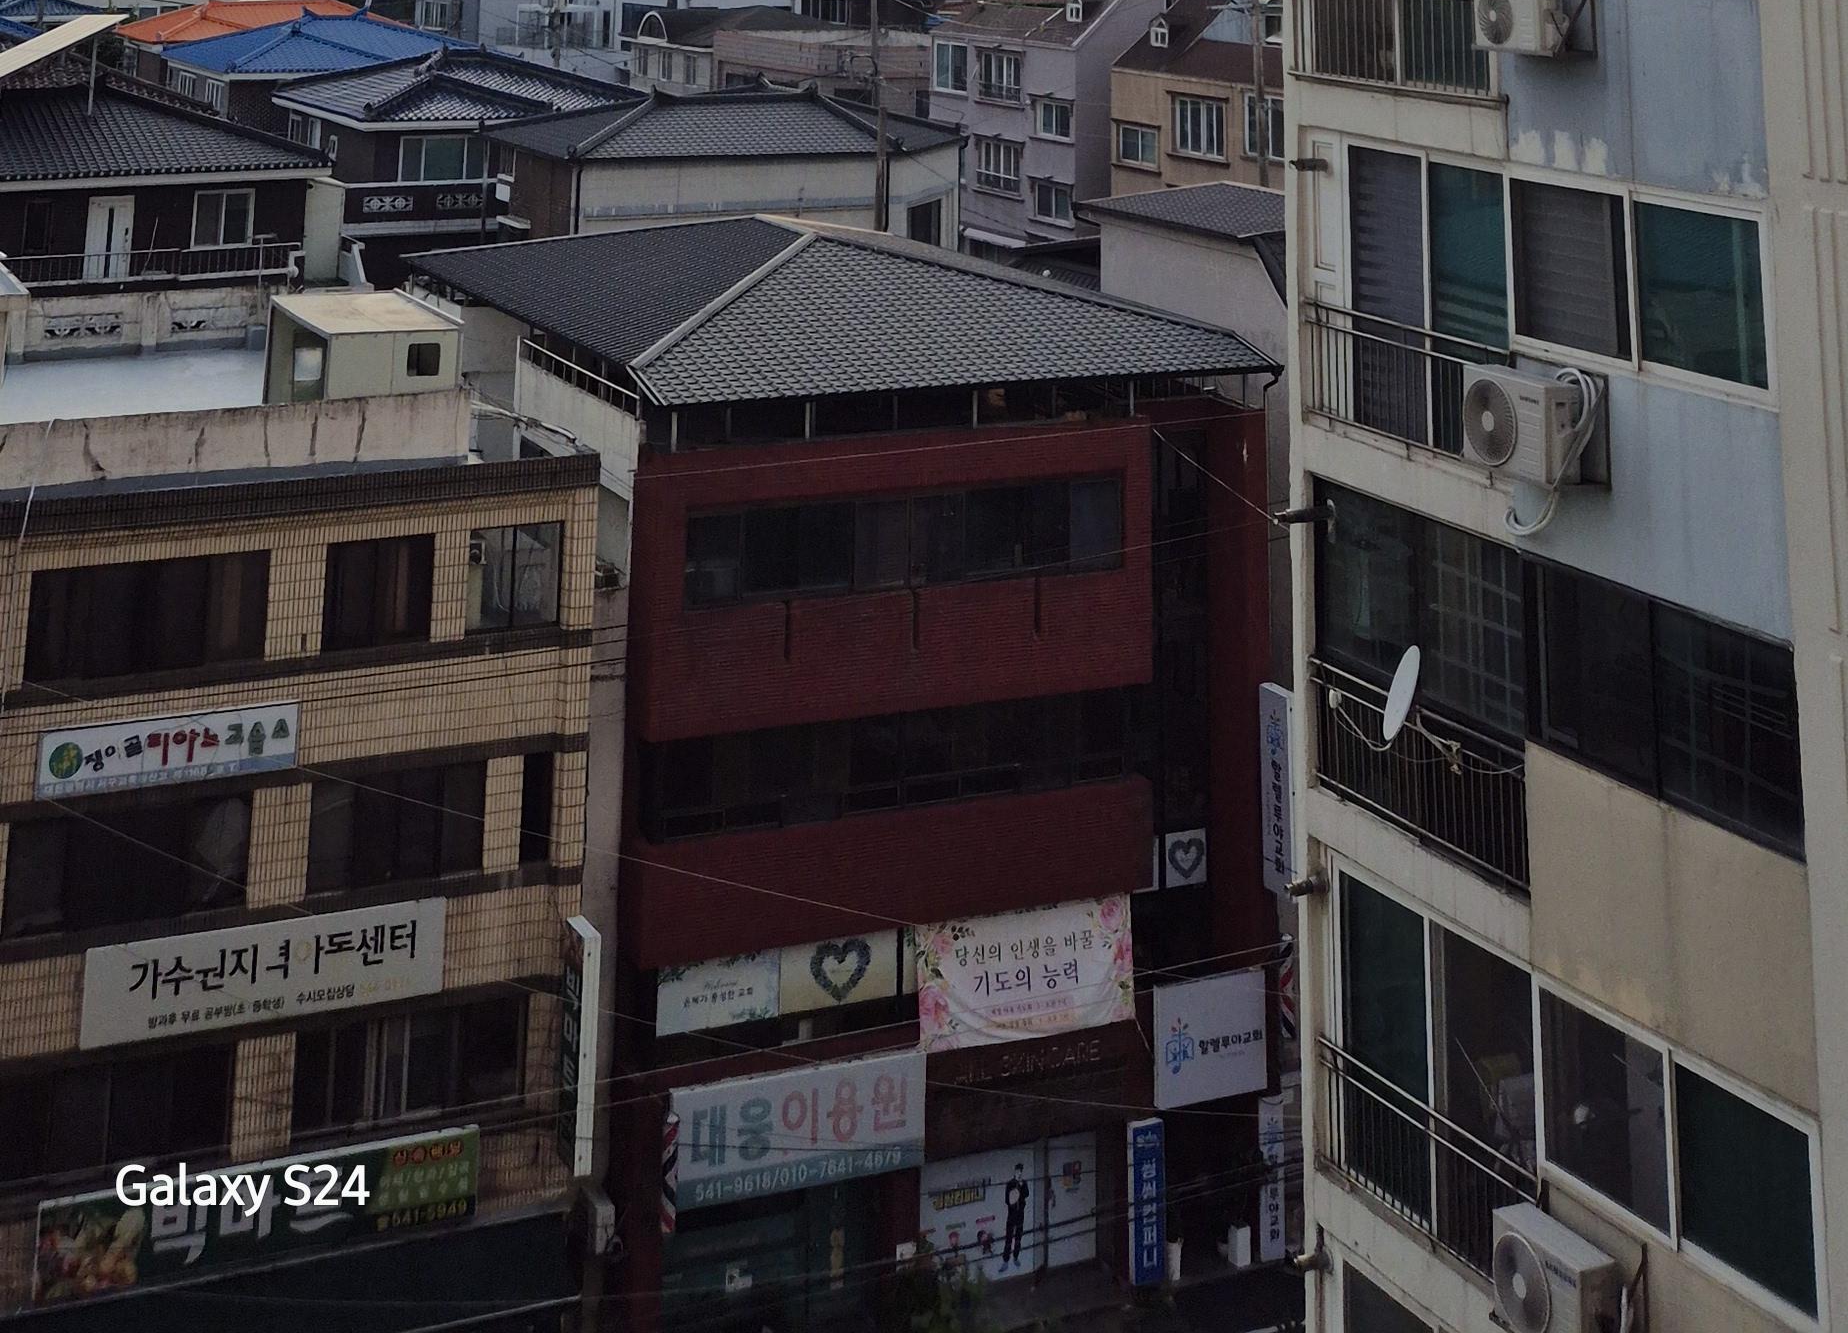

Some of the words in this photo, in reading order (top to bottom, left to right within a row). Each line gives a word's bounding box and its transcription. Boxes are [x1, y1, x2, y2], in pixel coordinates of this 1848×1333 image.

[955, 943, 1002, 967] 당신의
[1010, 935, 1057, 960] 인생을
[1064, 929, 1095, 952] 바꿀
[974, 965, 1032, 997] 기도의
[1042, 959, 1079, 990] 능력
[147, 1012, 177, 1029] 방과후
[181, 1009, 200, 1023] 무료
[1198, 1029, 1263, 1055] 할렐루야교회
